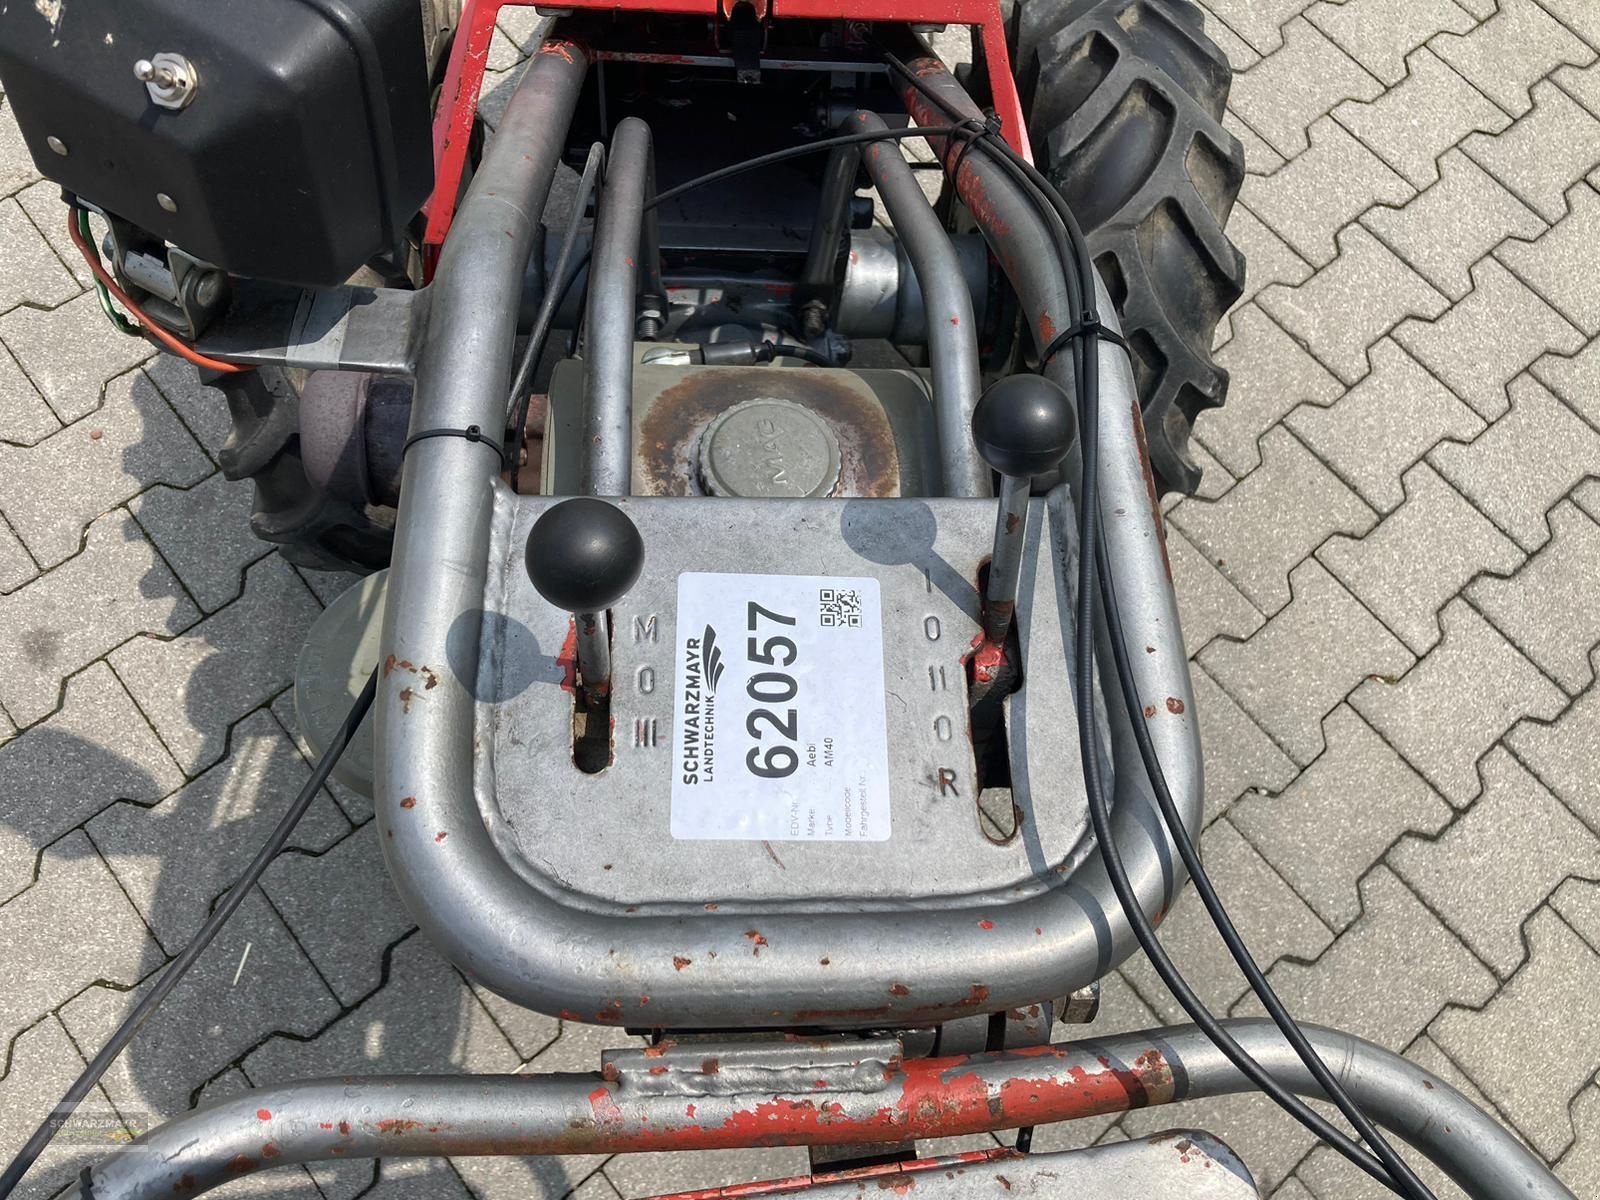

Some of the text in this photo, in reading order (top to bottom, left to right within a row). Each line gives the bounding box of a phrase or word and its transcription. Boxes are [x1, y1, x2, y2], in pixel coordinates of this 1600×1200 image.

[633, 615, 658, 643] M
[745, 600, 799, 779] 62057
[683, 637, 702, 786] SCHWARZMAYR
[703, 694, 715, 783] LANDTECHNIK
[824, 736, 834, 768] AM40
[806, 743, 817, 767] Aebi
[937, 767, 960, 798] R
